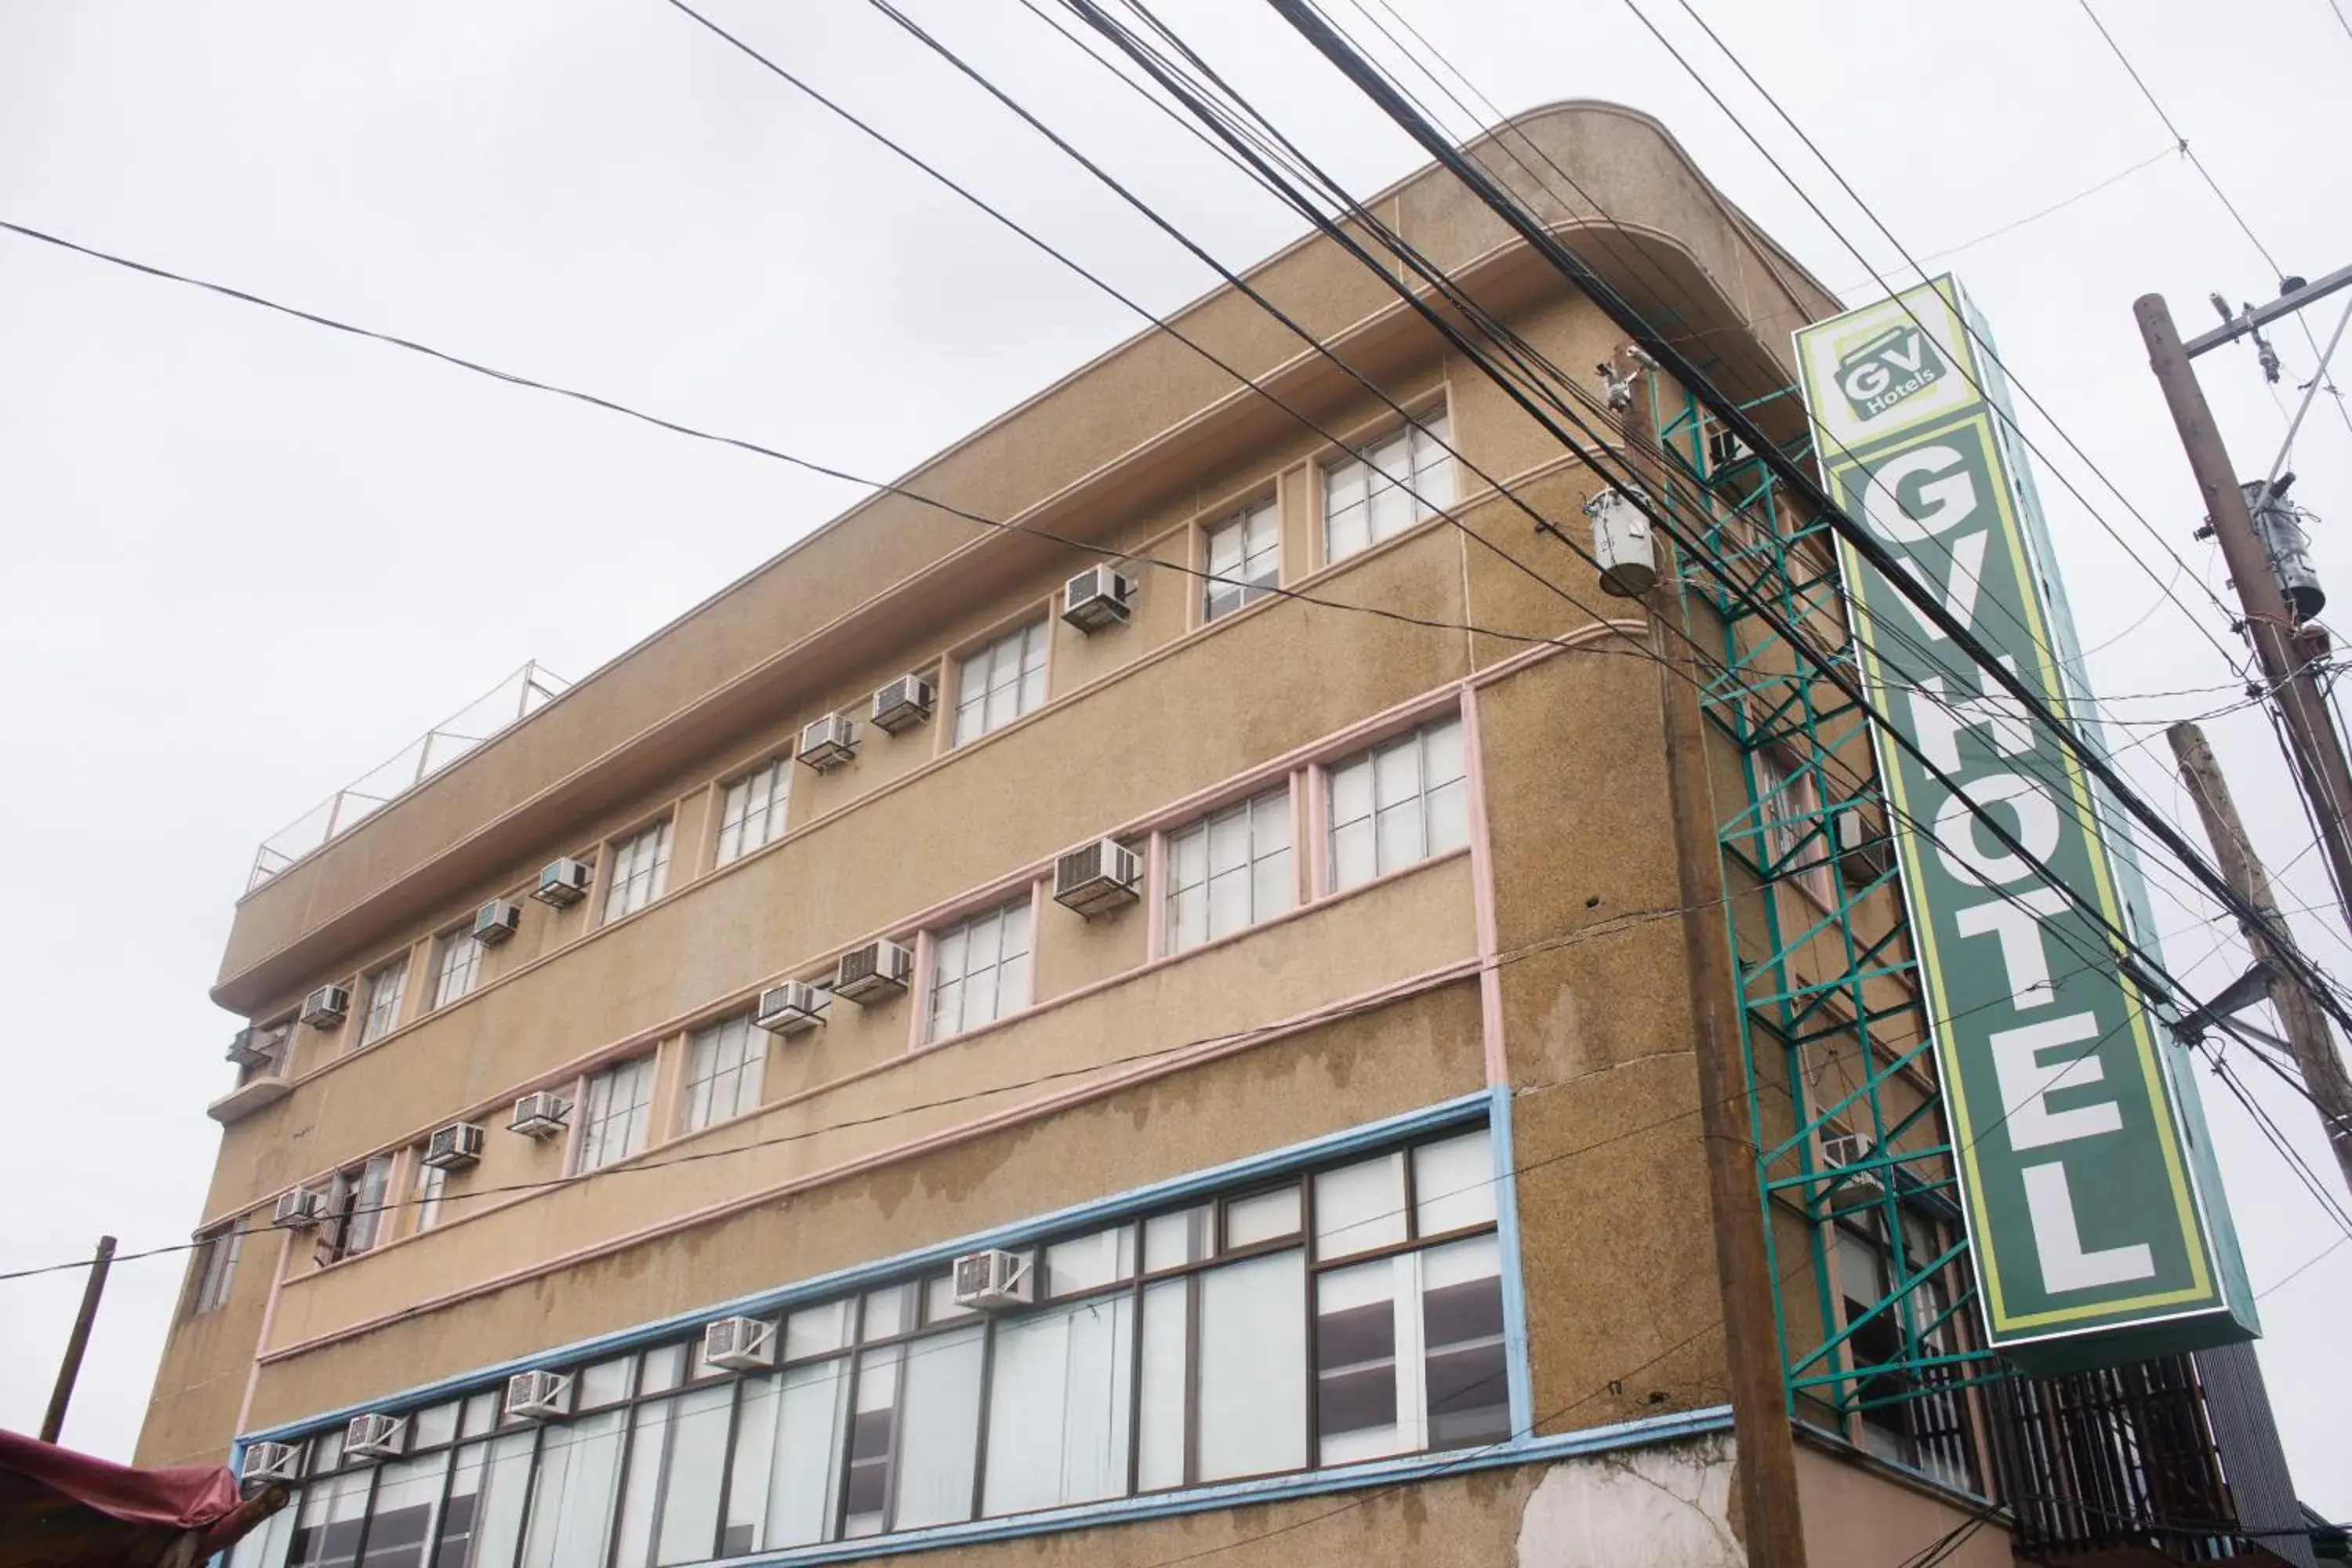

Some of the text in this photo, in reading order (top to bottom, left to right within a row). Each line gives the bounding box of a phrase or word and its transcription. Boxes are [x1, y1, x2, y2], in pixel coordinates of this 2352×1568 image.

[1846, 332, 1920, 401] GV
[1866, 368, 1935, 415] Hotels
[1908, 654, 2155, 1294] HOTEL
